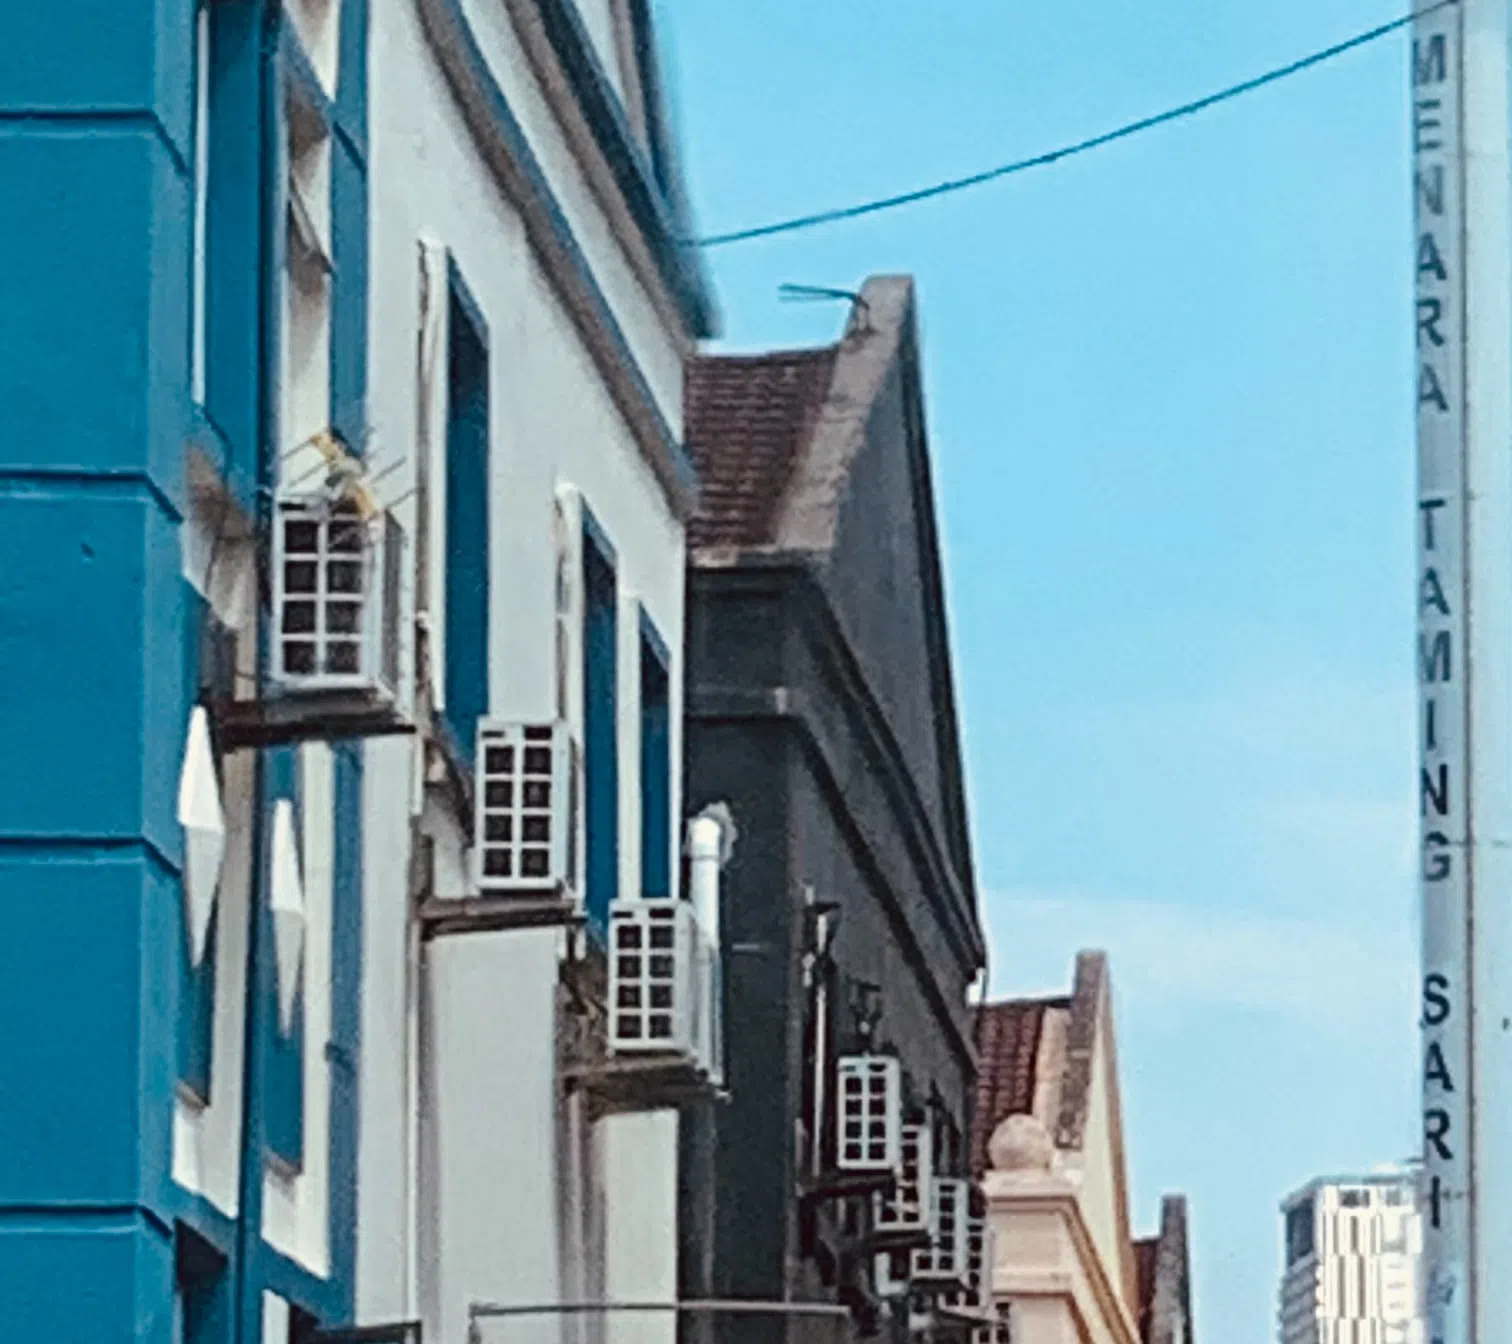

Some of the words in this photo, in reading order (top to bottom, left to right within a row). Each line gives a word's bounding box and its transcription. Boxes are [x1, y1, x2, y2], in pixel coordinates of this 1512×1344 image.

[1412, 33, 1450, 413] MENARA
[1418, 498, 1452, 884] TAMING
[1420, 973, 1456, 1230] SARI
